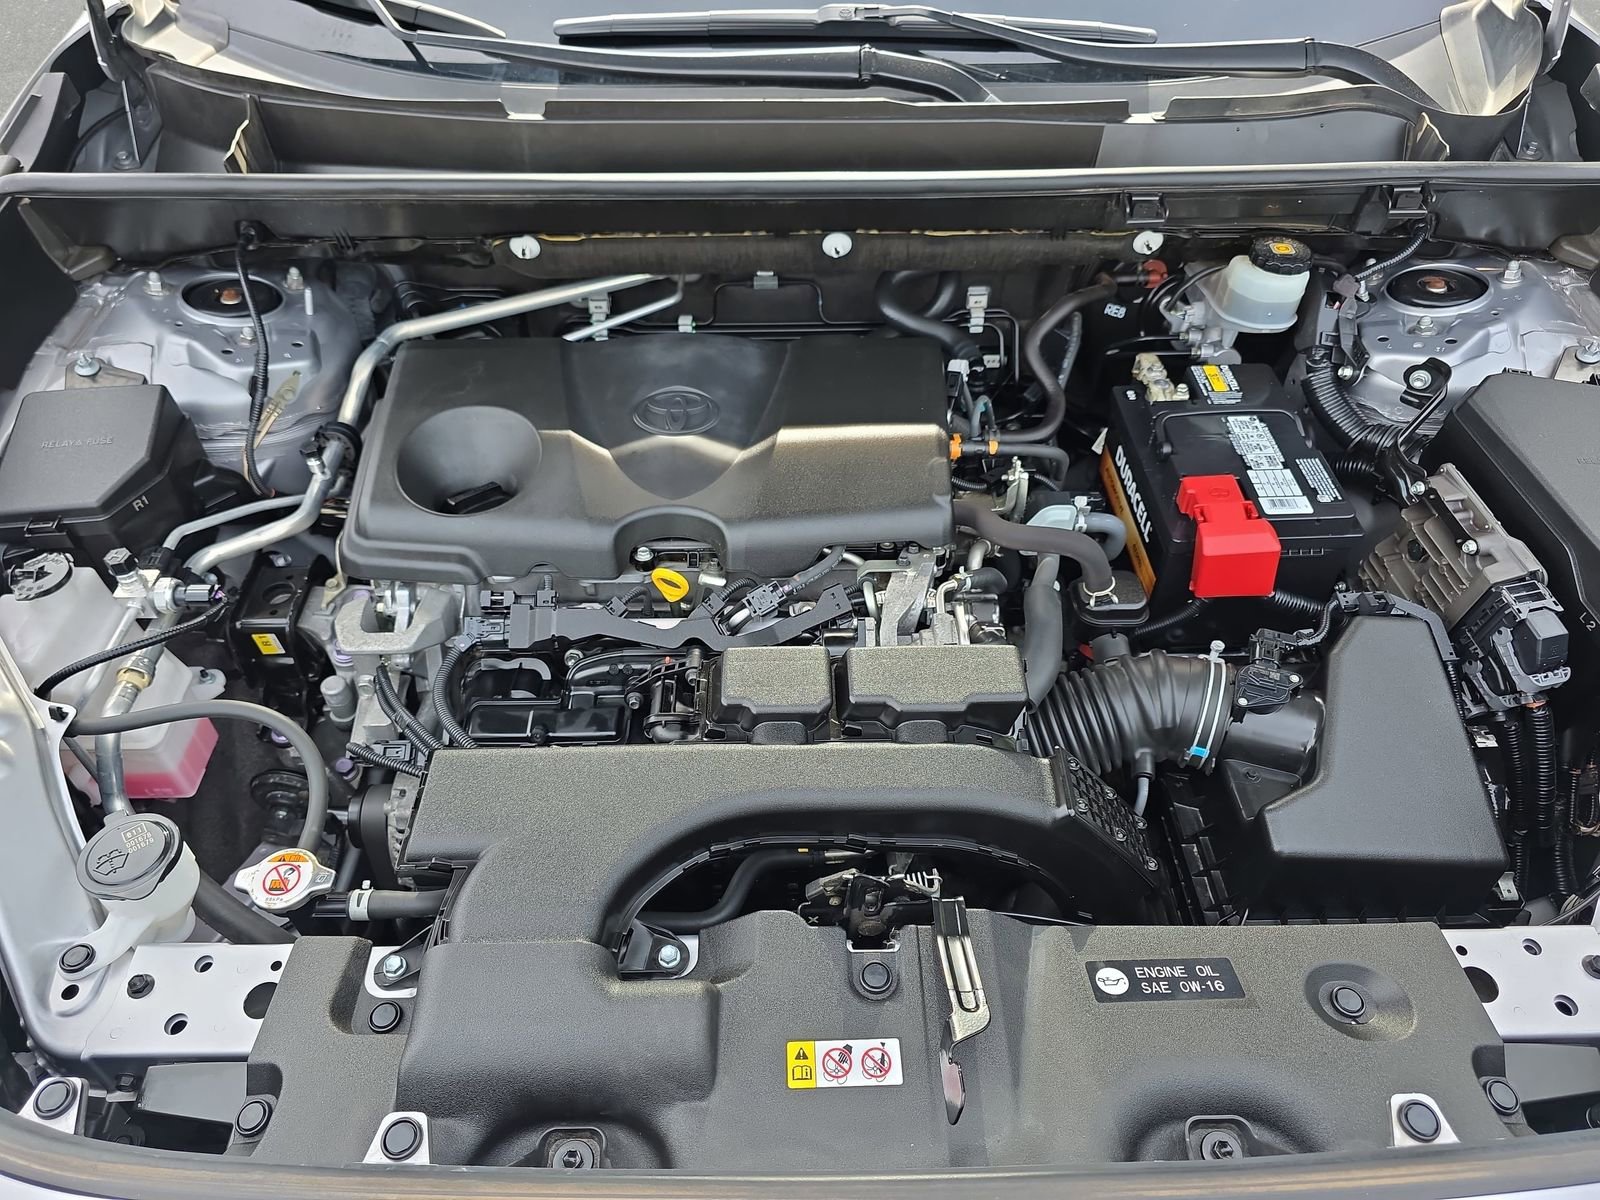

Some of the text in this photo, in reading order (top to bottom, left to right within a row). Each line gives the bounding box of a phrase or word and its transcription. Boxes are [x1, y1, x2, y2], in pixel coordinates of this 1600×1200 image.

[86, 436, 113, 446] FUSE
[1115, 445, 1151, 543] DURACELL
[132, 495, 150, 511] R1
[1134, 965, 1219, 978] ENGINE OIL
[1141, 980, 1225, 994] SAE 0W-16
